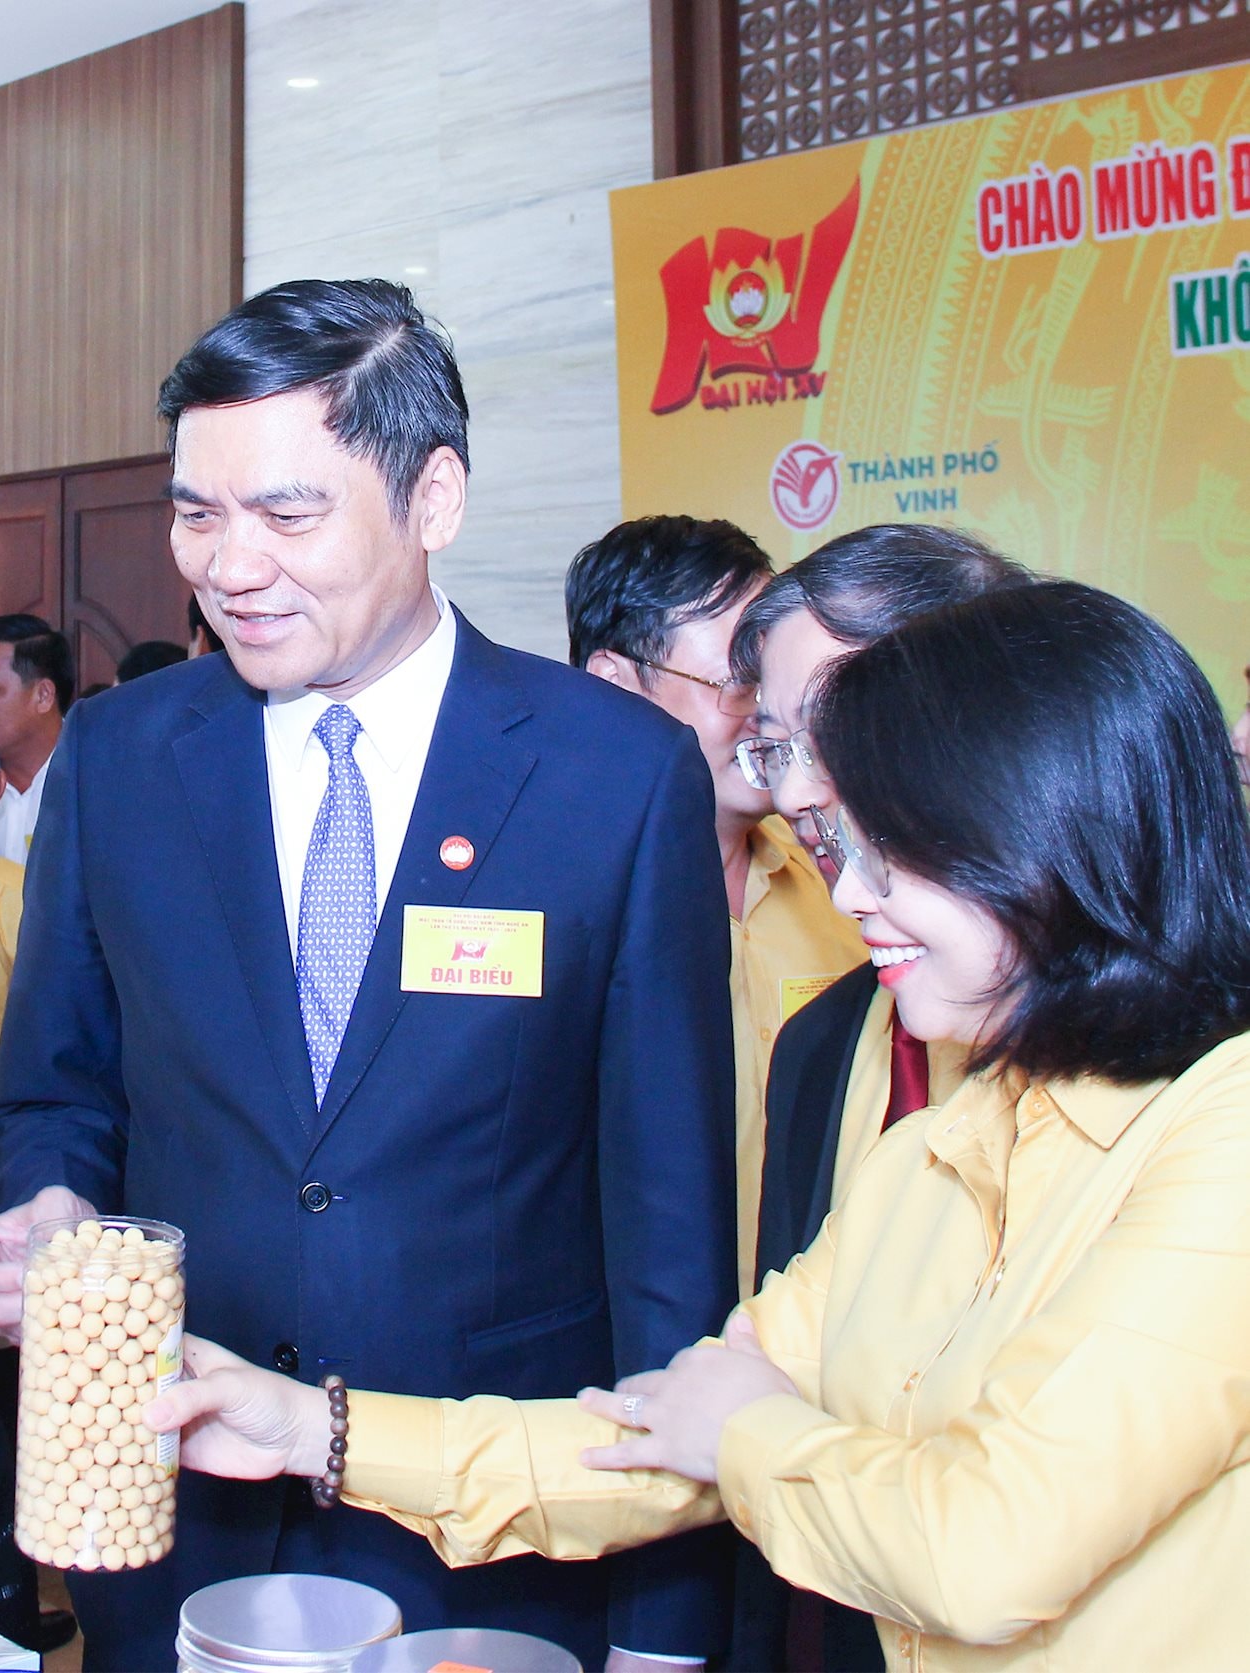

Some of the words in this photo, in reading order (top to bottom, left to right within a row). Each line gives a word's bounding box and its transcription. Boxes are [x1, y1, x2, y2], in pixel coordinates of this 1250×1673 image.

[980, 168, 1081, 252] CHÀO
[1096, 147, 1216, 235] MỪNG
[847, 453, 934, 484] THÀNH
[943, 439, 1000, 476] PHỐ
[895, 487, 958, 513] VINH
[431, 967, 463, 986] ĐẠI
[469, 963, 513, 986] BIỂU
